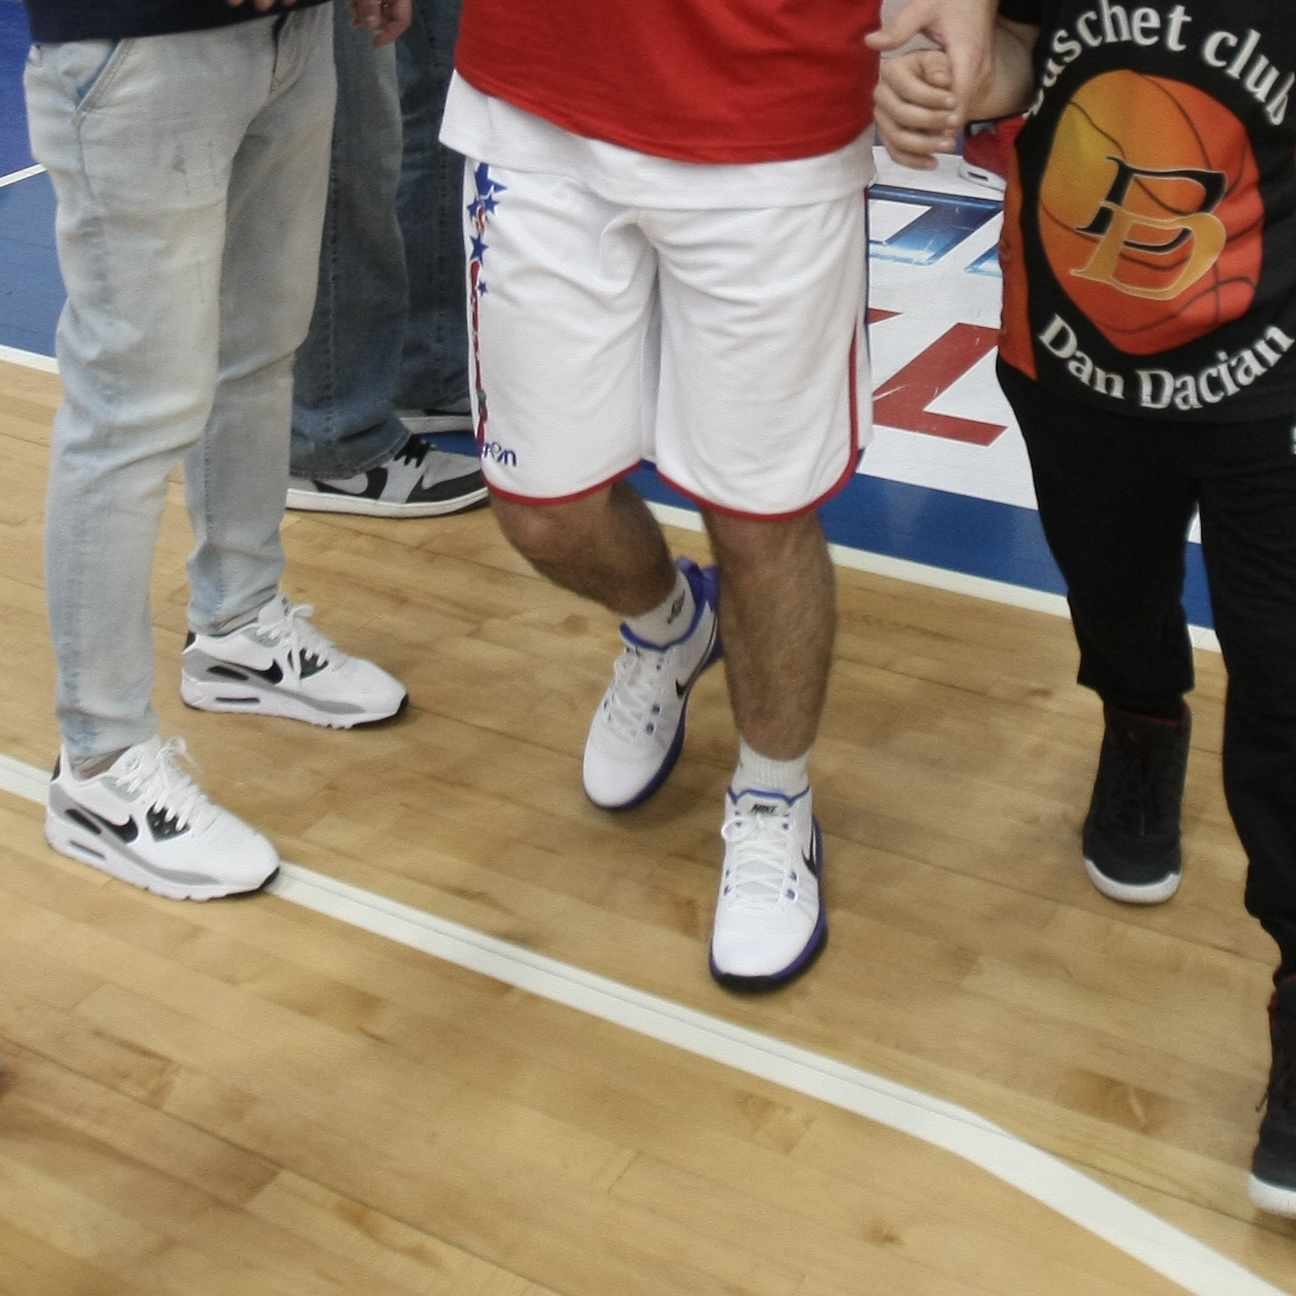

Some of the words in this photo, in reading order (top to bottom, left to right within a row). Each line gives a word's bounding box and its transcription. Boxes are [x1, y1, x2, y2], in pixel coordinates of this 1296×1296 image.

[1203, 28, 1296, 126] club
[1038, 313, 1125, 400] Dan
[1135, 325, 1296, 411] Dacian
